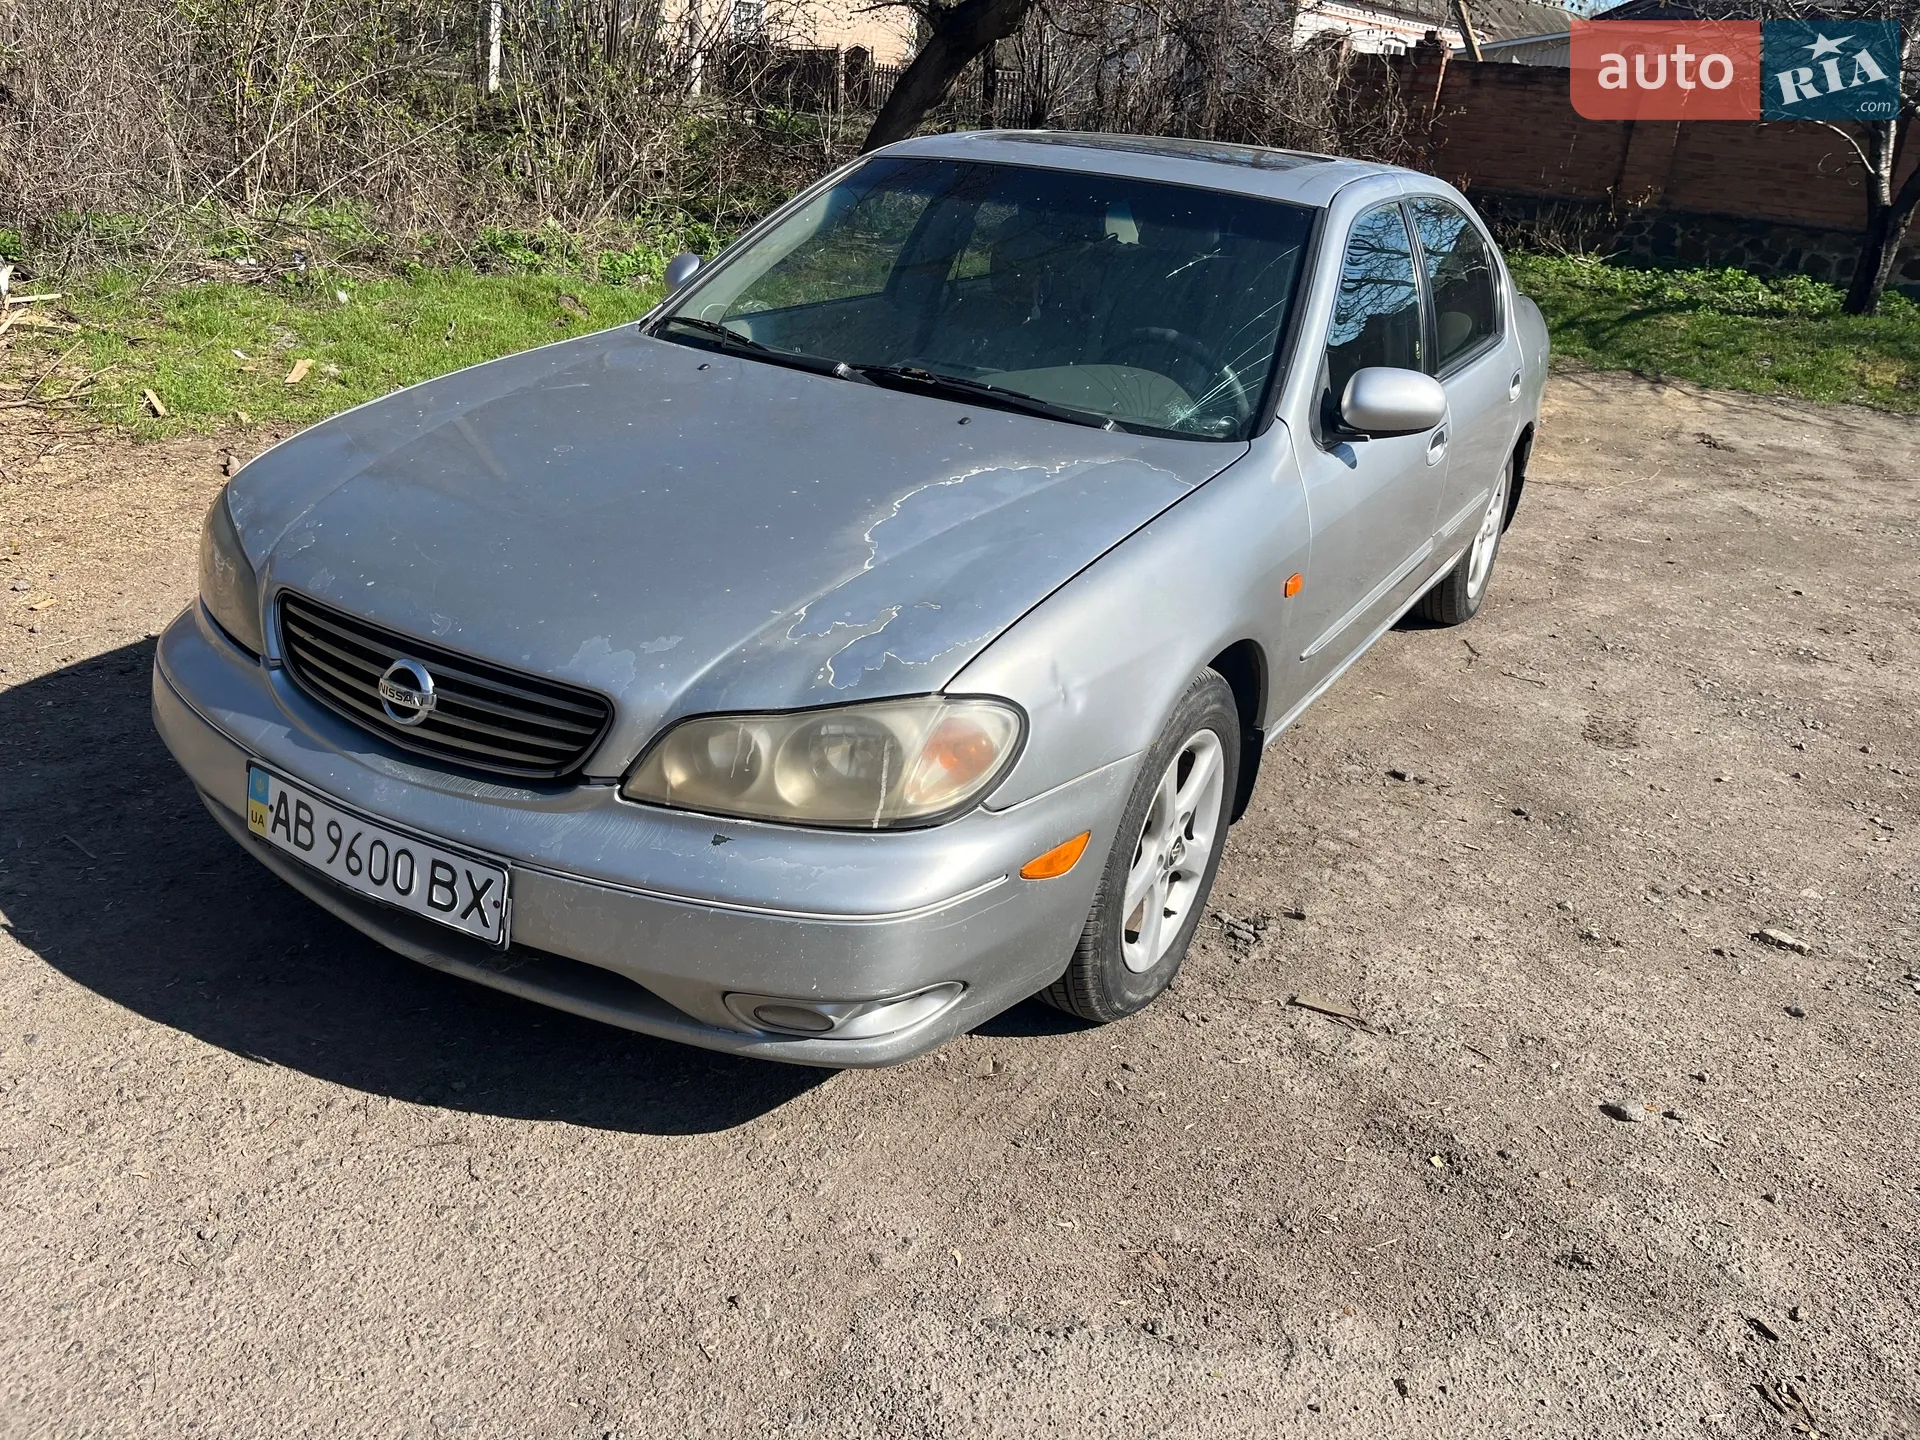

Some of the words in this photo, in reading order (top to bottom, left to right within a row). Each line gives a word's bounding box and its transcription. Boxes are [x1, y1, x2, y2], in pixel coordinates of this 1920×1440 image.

[379, 682, 425, 707] NISSAN
[251, 809, 265, 828] UA
[271, 790, 316, 852] AB
[326, 820, 417, 897] 9600
[427, 859, 495, 929] BX
